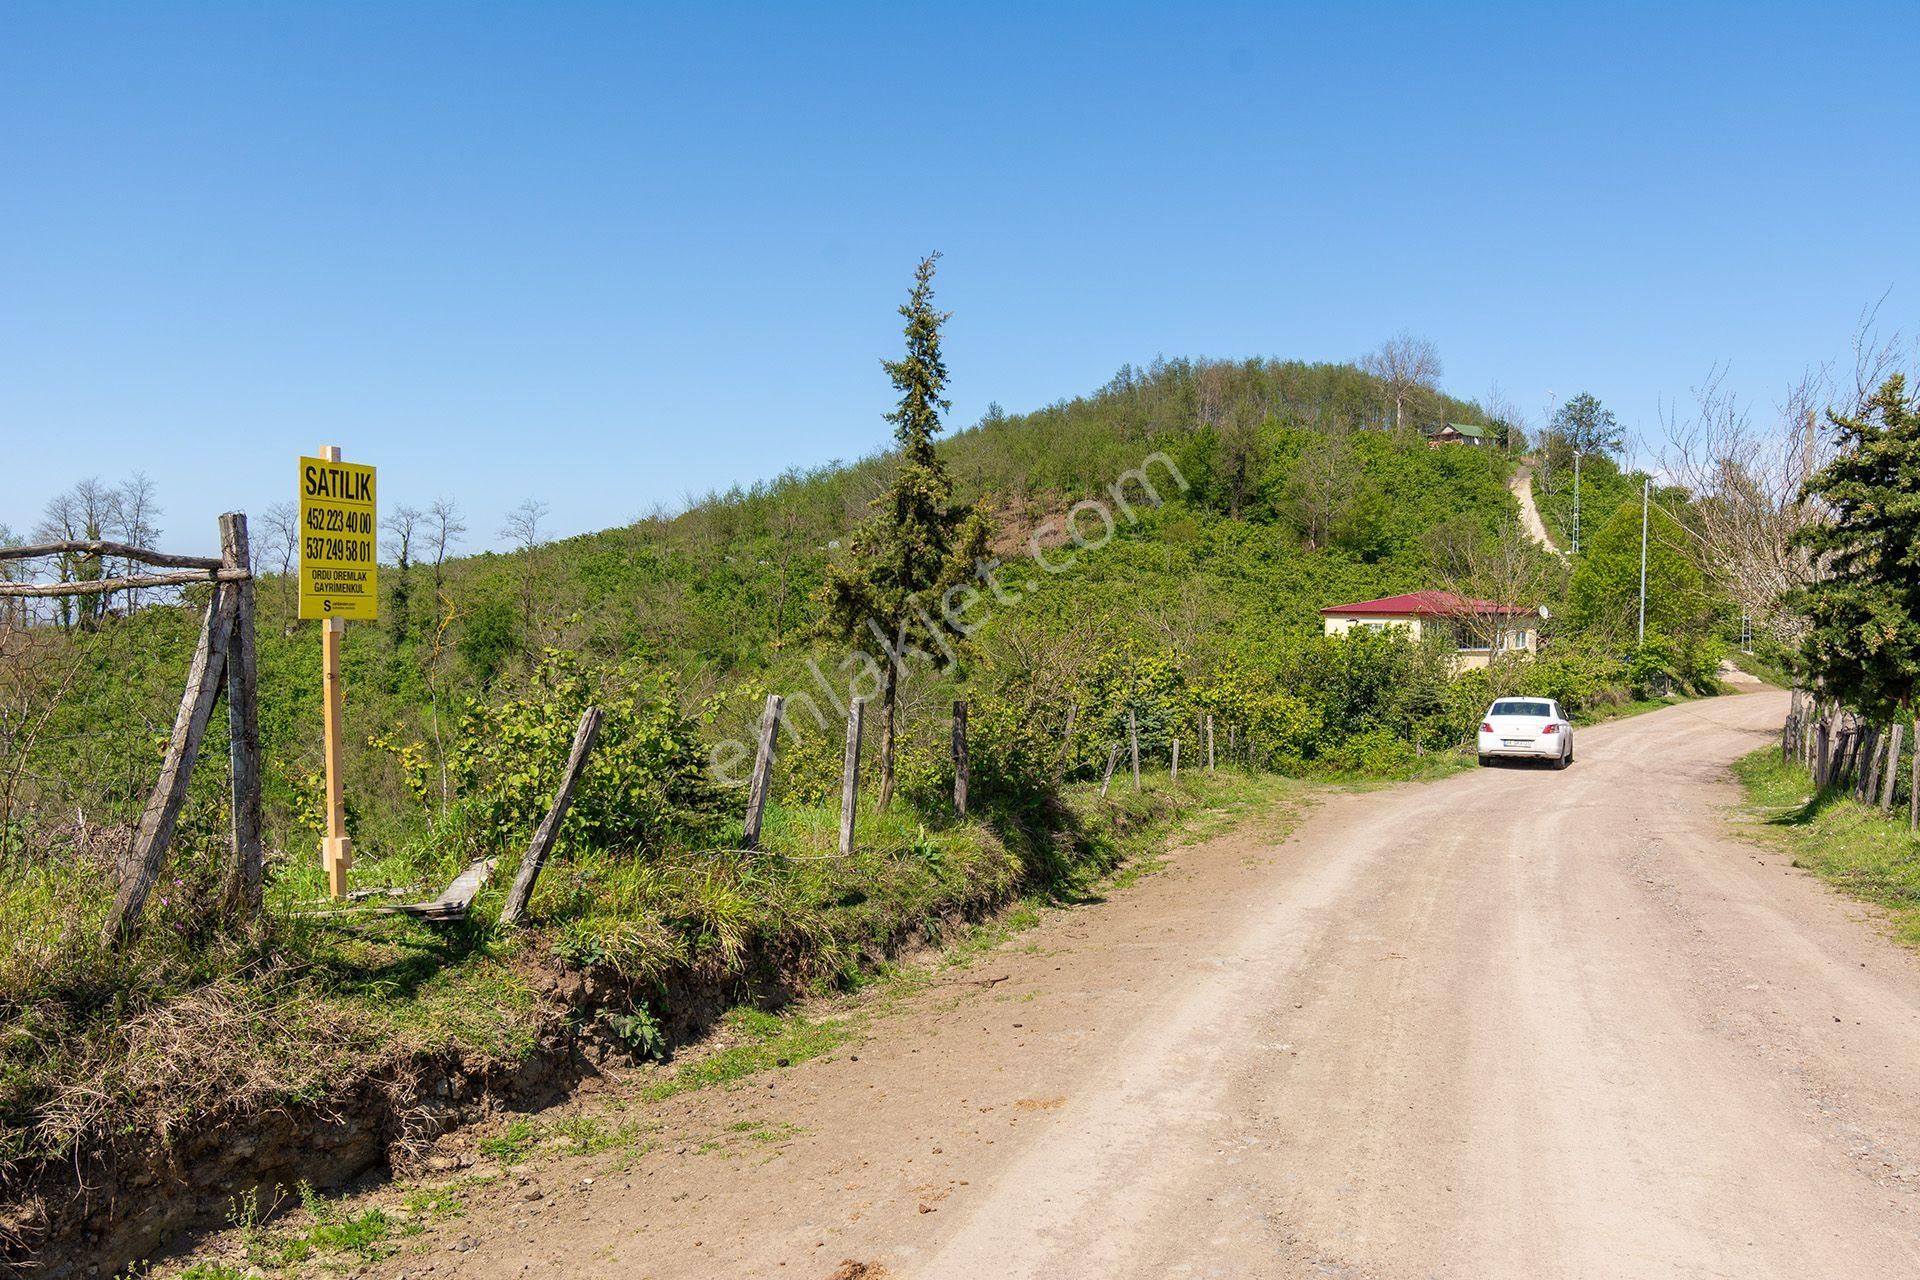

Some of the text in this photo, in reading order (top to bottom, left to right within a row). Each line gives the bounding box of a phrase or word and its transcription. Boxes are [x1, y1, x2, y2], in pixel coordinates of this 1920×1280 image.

[305, 466, 372, 501] SATILIK
[307, 507, 371, 534] 452 223 40 00
[306, 537, 371, 562] 537 249 58 01
[312, 569, 367, 581] ORDU OREMLAK
[314, 581, 365, 593] GAYRİMENKUL
[323, 600, 332, 612] S
